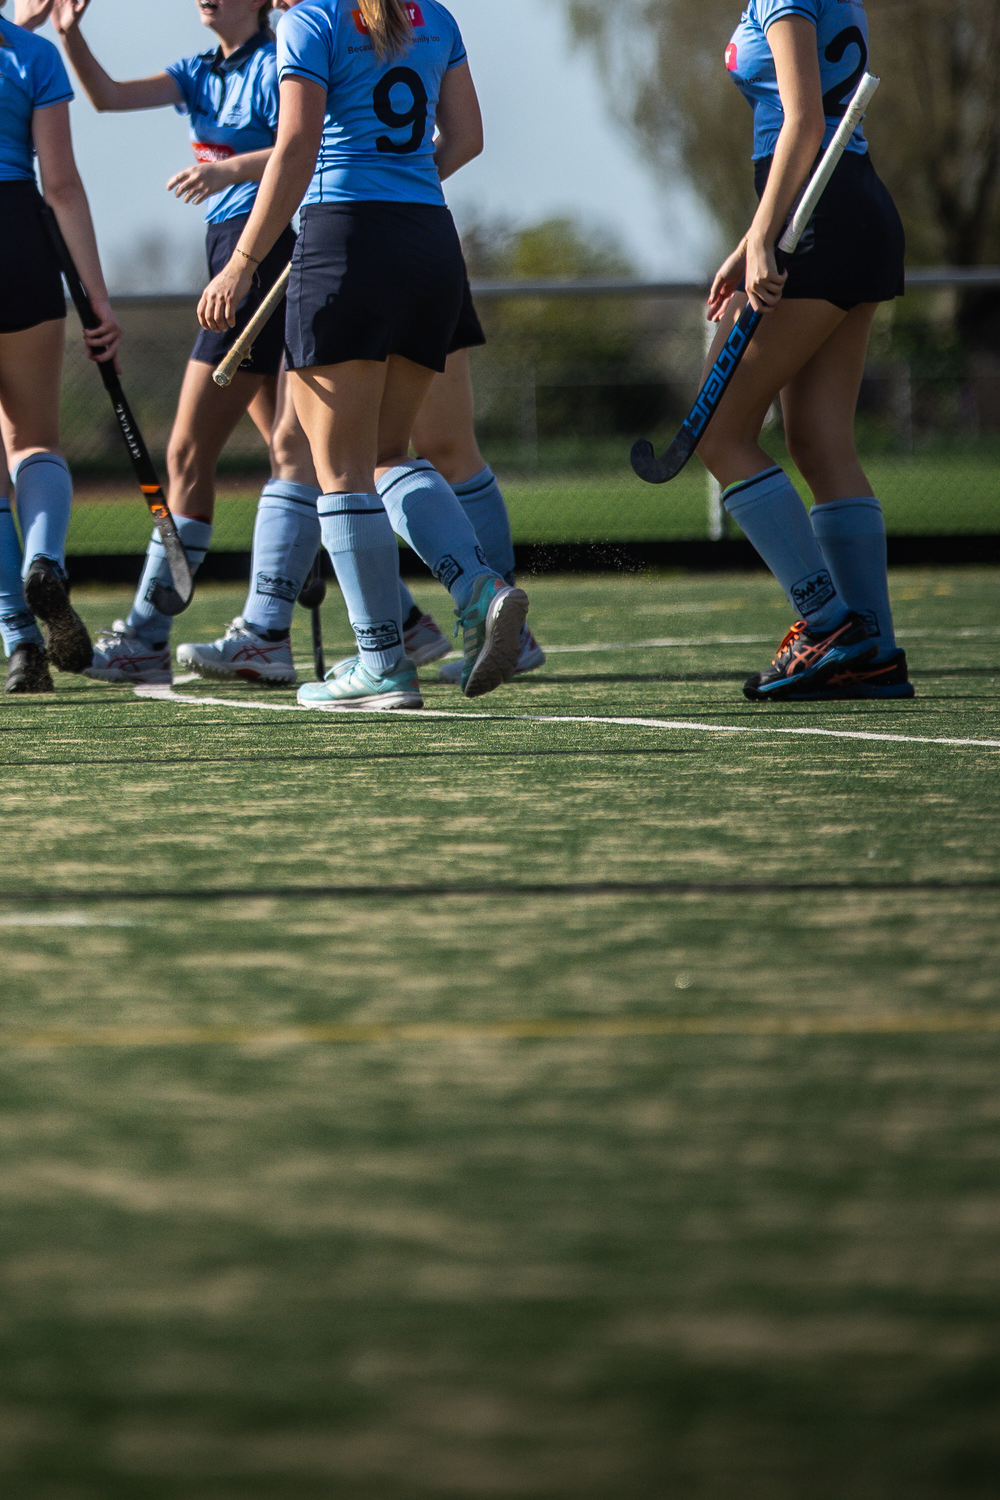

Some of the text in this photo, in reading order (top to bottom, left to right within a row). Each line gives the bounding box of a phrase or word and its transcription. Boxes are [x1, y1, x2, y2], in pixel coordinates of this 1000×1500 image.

[347, 44, 375, 55] Becau
[821, 26, 868, 117] 2
[372, 66, 428, 154] 9
